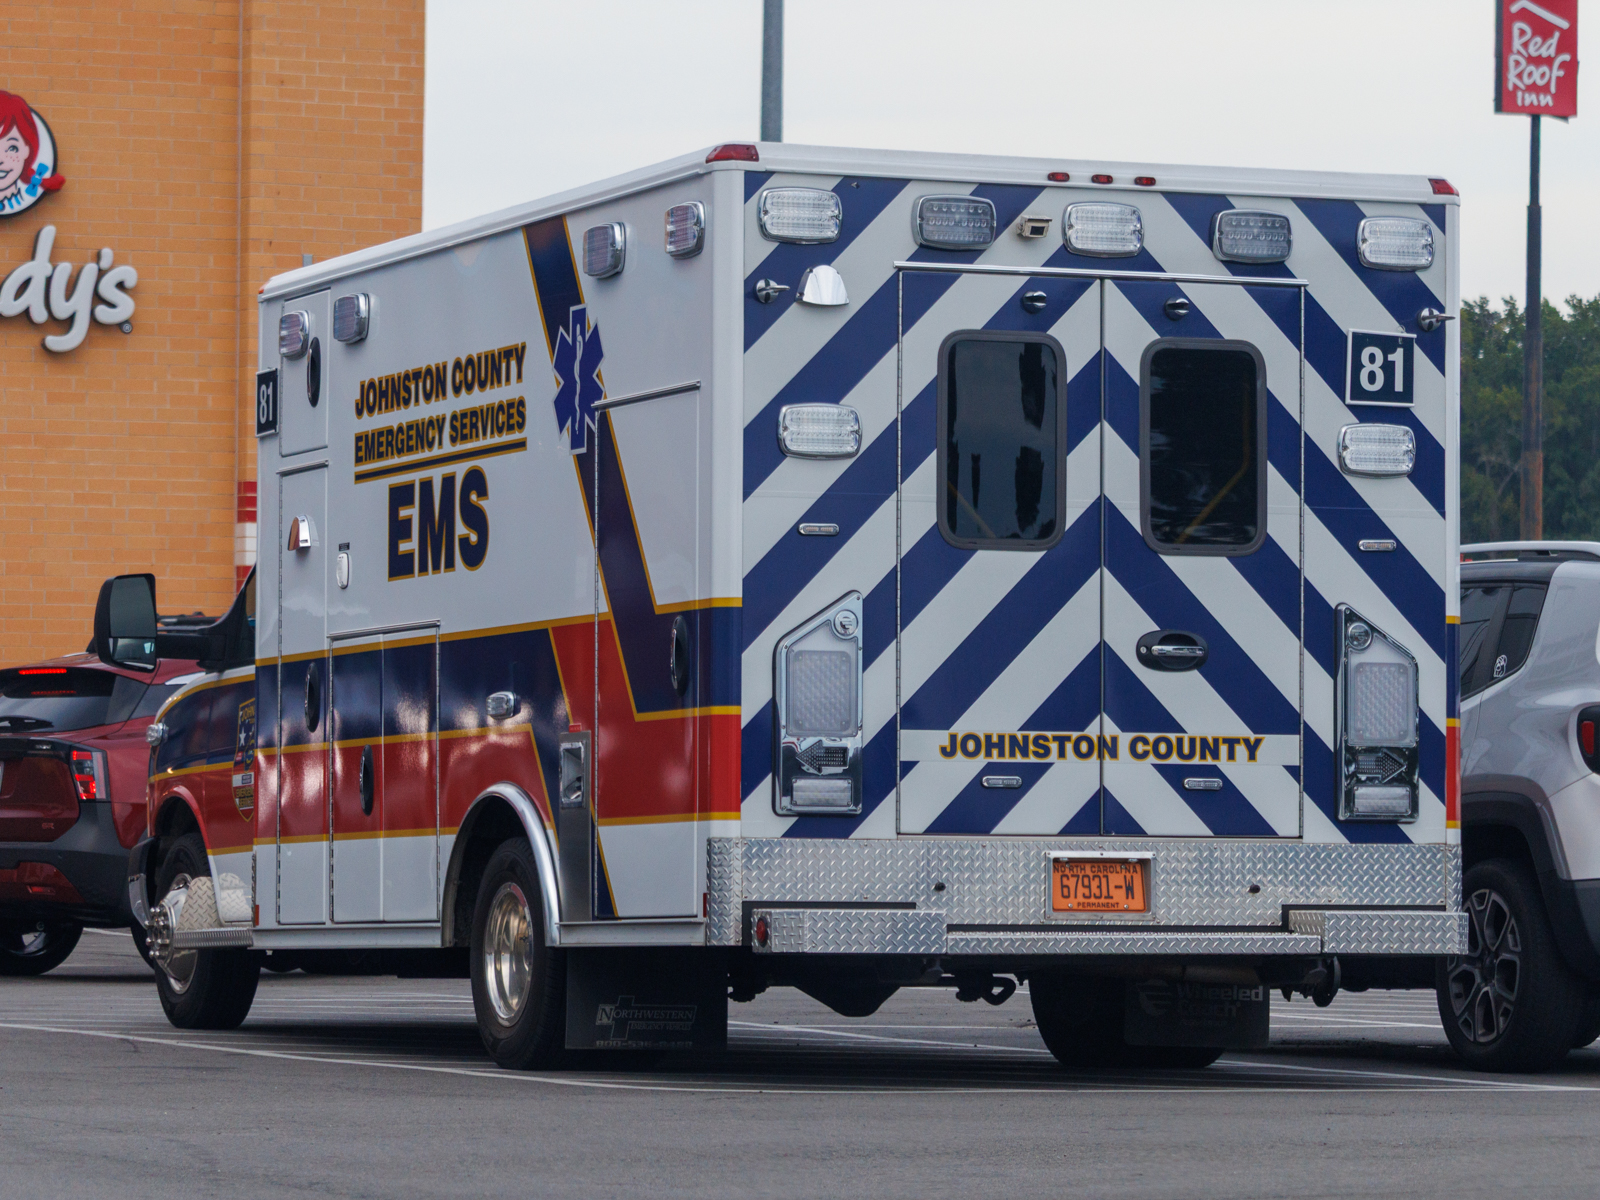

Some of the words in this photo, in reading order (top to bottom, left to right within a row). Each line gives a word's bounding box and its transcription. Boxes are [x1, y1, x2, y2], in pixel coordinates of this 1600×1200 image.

[1512, 21, 1560, 58] Red
[1507, 53, 1571, 94] Roof
[355, 361, 448, 420] JOHNSTON
[451, 342, 527, 399] COUNTY
[1359, 346, 1404, 393] 81
[259, 381, 273, 424] 81
[354, 413, 447, 467] EMERGENCY
[449, 395, 527, 447] SERVICES
[387, 465, 490, 582] EMS
[938, 731, 1120, 762] JOHNSTON
[1128, 734, 1265, 763] COUNTY
[1053, 864, 1086, 874] NORTH
[1090, 865, 1138, 874] CAROLINA
[1060, 874, 1135, 899] 67931-W
[1176, 983, 1264, 1002] Wheeled
[599, 1007, 694, 1021] NORTHWESTERN
